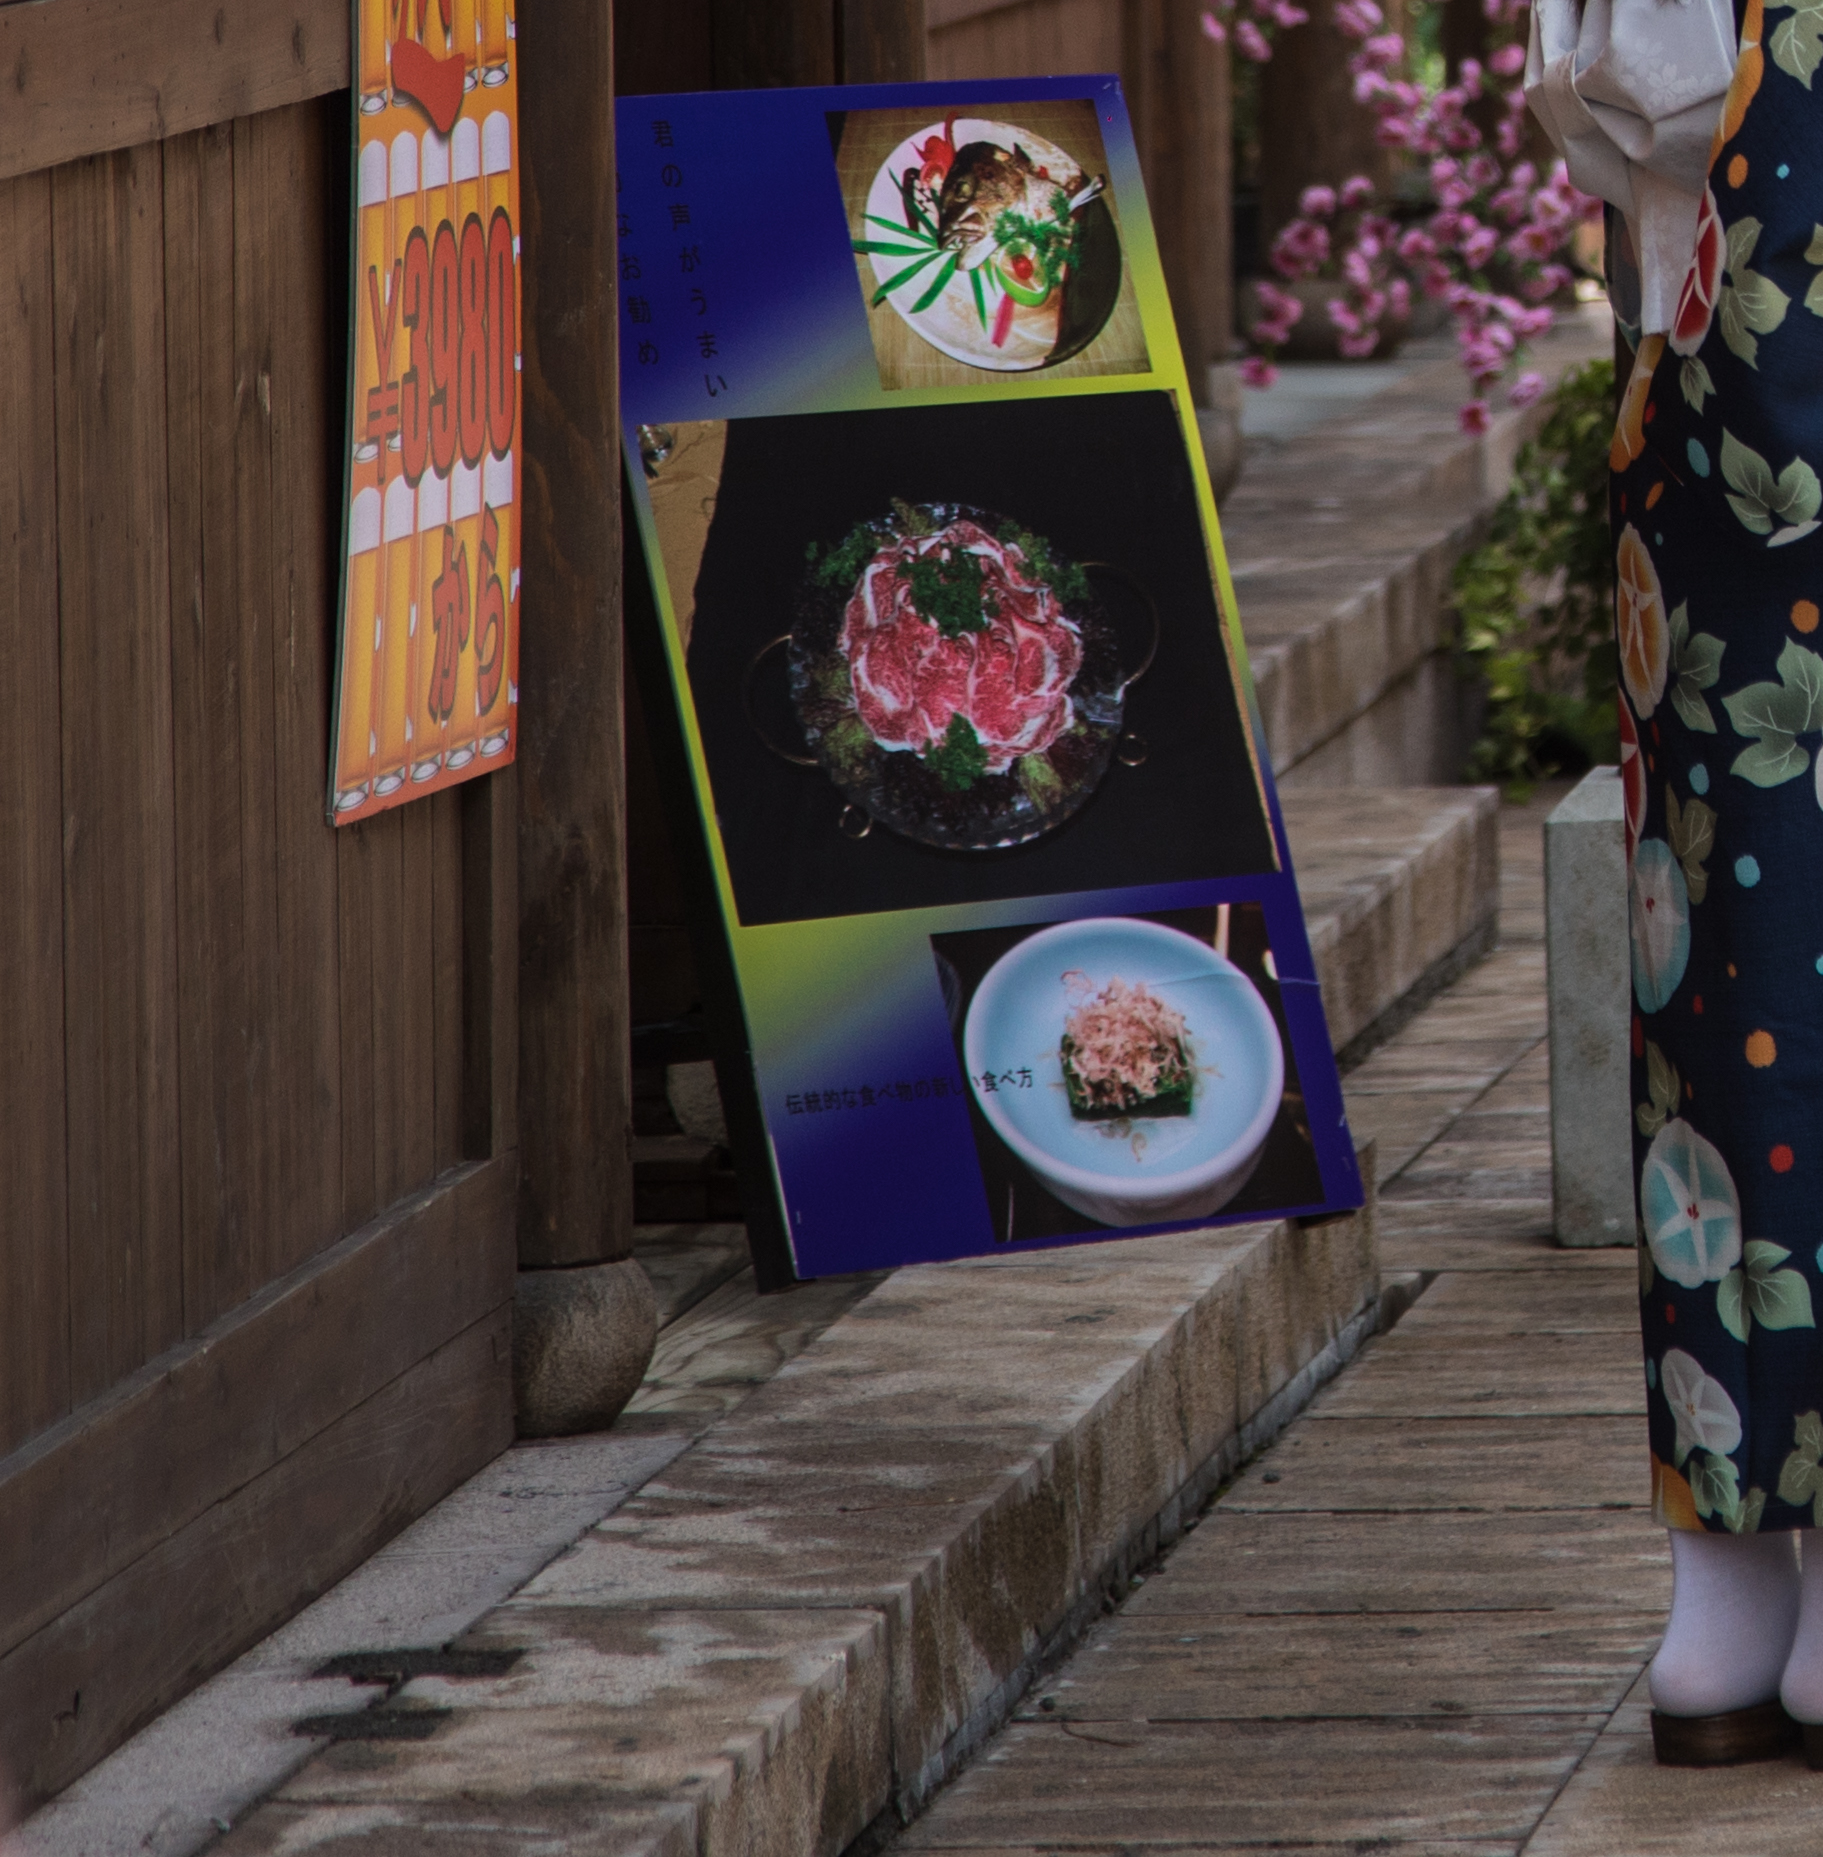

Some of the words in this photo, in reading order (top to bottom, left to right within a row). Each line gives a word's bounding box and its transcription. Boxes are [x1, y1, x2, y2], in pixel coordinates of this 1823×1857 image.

[366, 205, 514, 490] ¥3980
[616, 172, 659, 365] なお勧め
[651, 120, 728, 397] 君の声がうまい
[428, 501, 506, 725] から
